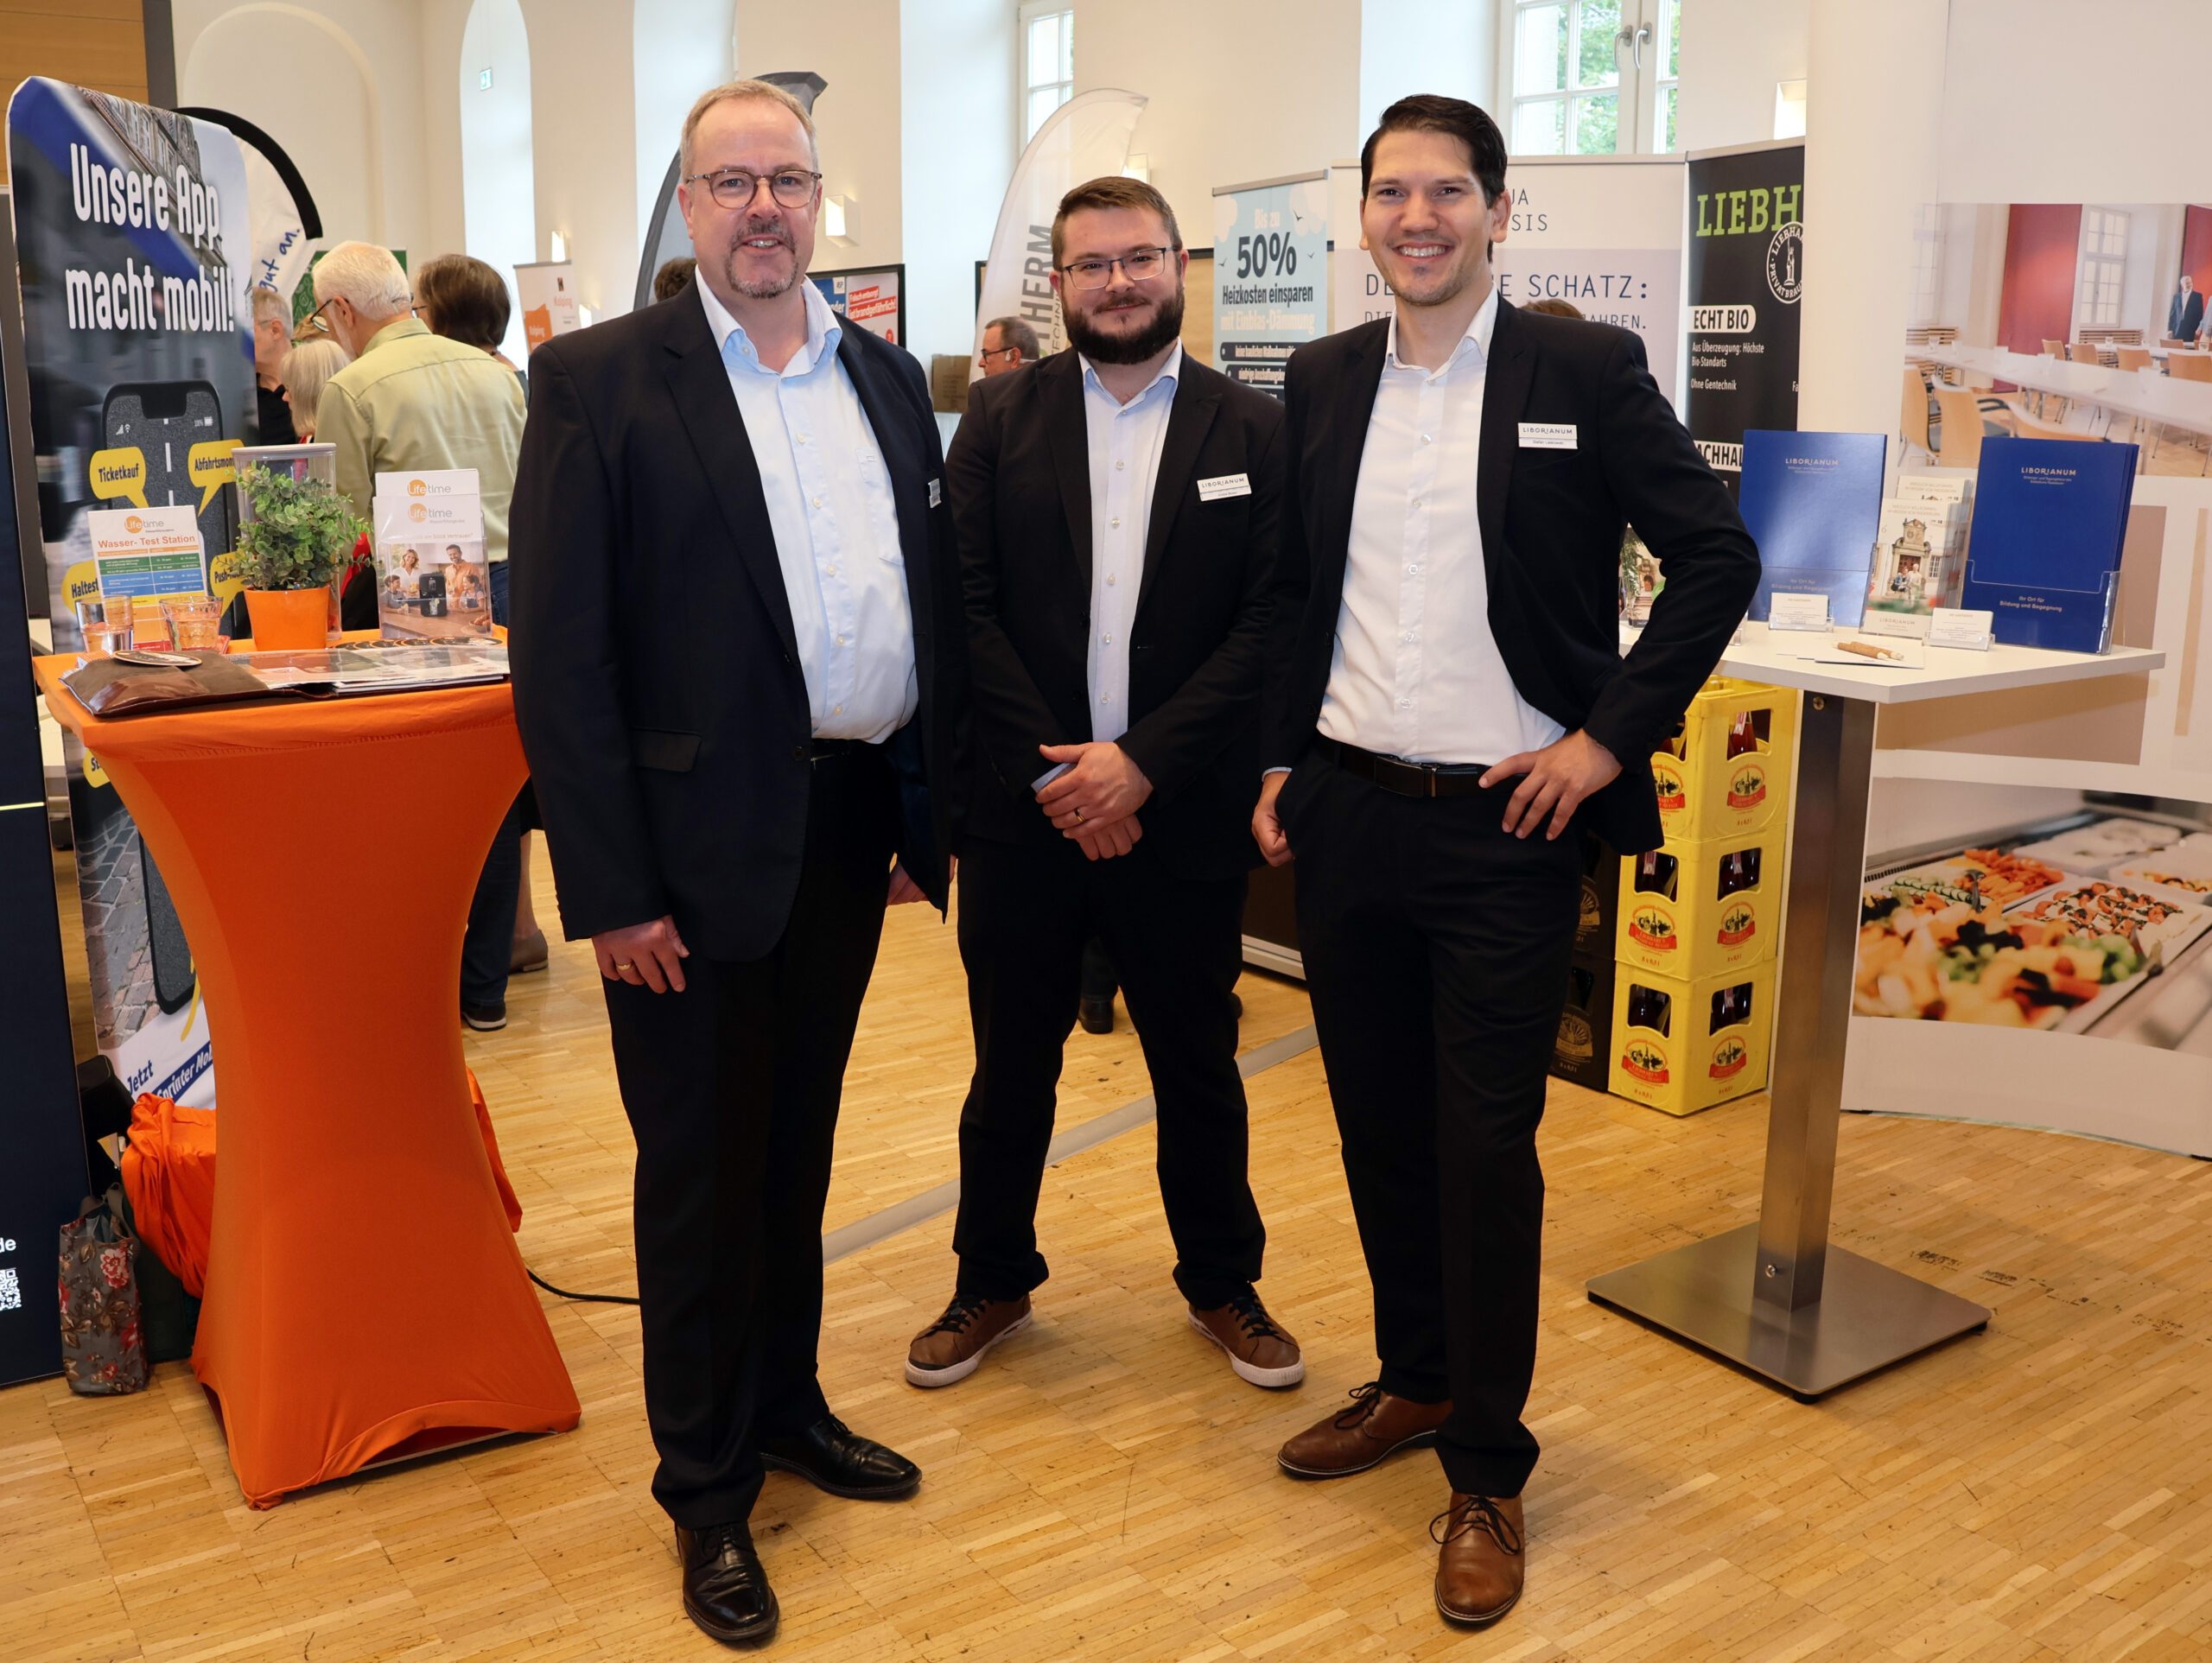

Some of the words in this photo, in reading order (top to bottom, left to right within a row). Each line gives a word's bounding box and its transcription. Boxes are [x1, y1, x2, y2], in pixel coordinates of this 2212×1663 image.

[70, 143, 169, 232] Unsere
[175, 164, 220, 250] App
[1255, 208, 1268, 229] Bis
[1269, 210, 1281, 227] zu
[1695, 184, 1802, 237] LIEBH
[1510, 214, 1548, 232] SIS
[1236, 232, 1297, 279] 50%
[65, 257, 157, 330] macht
[162, 264, 234, 333] mobil!
[1222, 284, 1268, 305] Heizkosten
[1268, 282, 1313, 308] einsparen
[1528, 274, 1648, 299] SCHATZ:
[1220, 310, 1234, 331] mit
[1694, 309, 1724, 330] ECHT
[1727, 308, 1750, 330] BIO
[1742, 341, 1764, 353] Höchste
[1690, 378, 1704, 390] Ohne
[1705, 378, 1737, 390] Gentechnik
[98, 463, 139, 483] Ticketkauf
[2020, 467, 2077, 476] LIBORIANUM
[408, 482, 452, 495] Lifetime
[98, 539, 138, 549] Wasser-
[139, 537, 160, 546] Test
[162, 535, 195, 544] Station
[71, 578, 99, 598] Haltest
[127, 1059, 154, 1095] Jetzt
